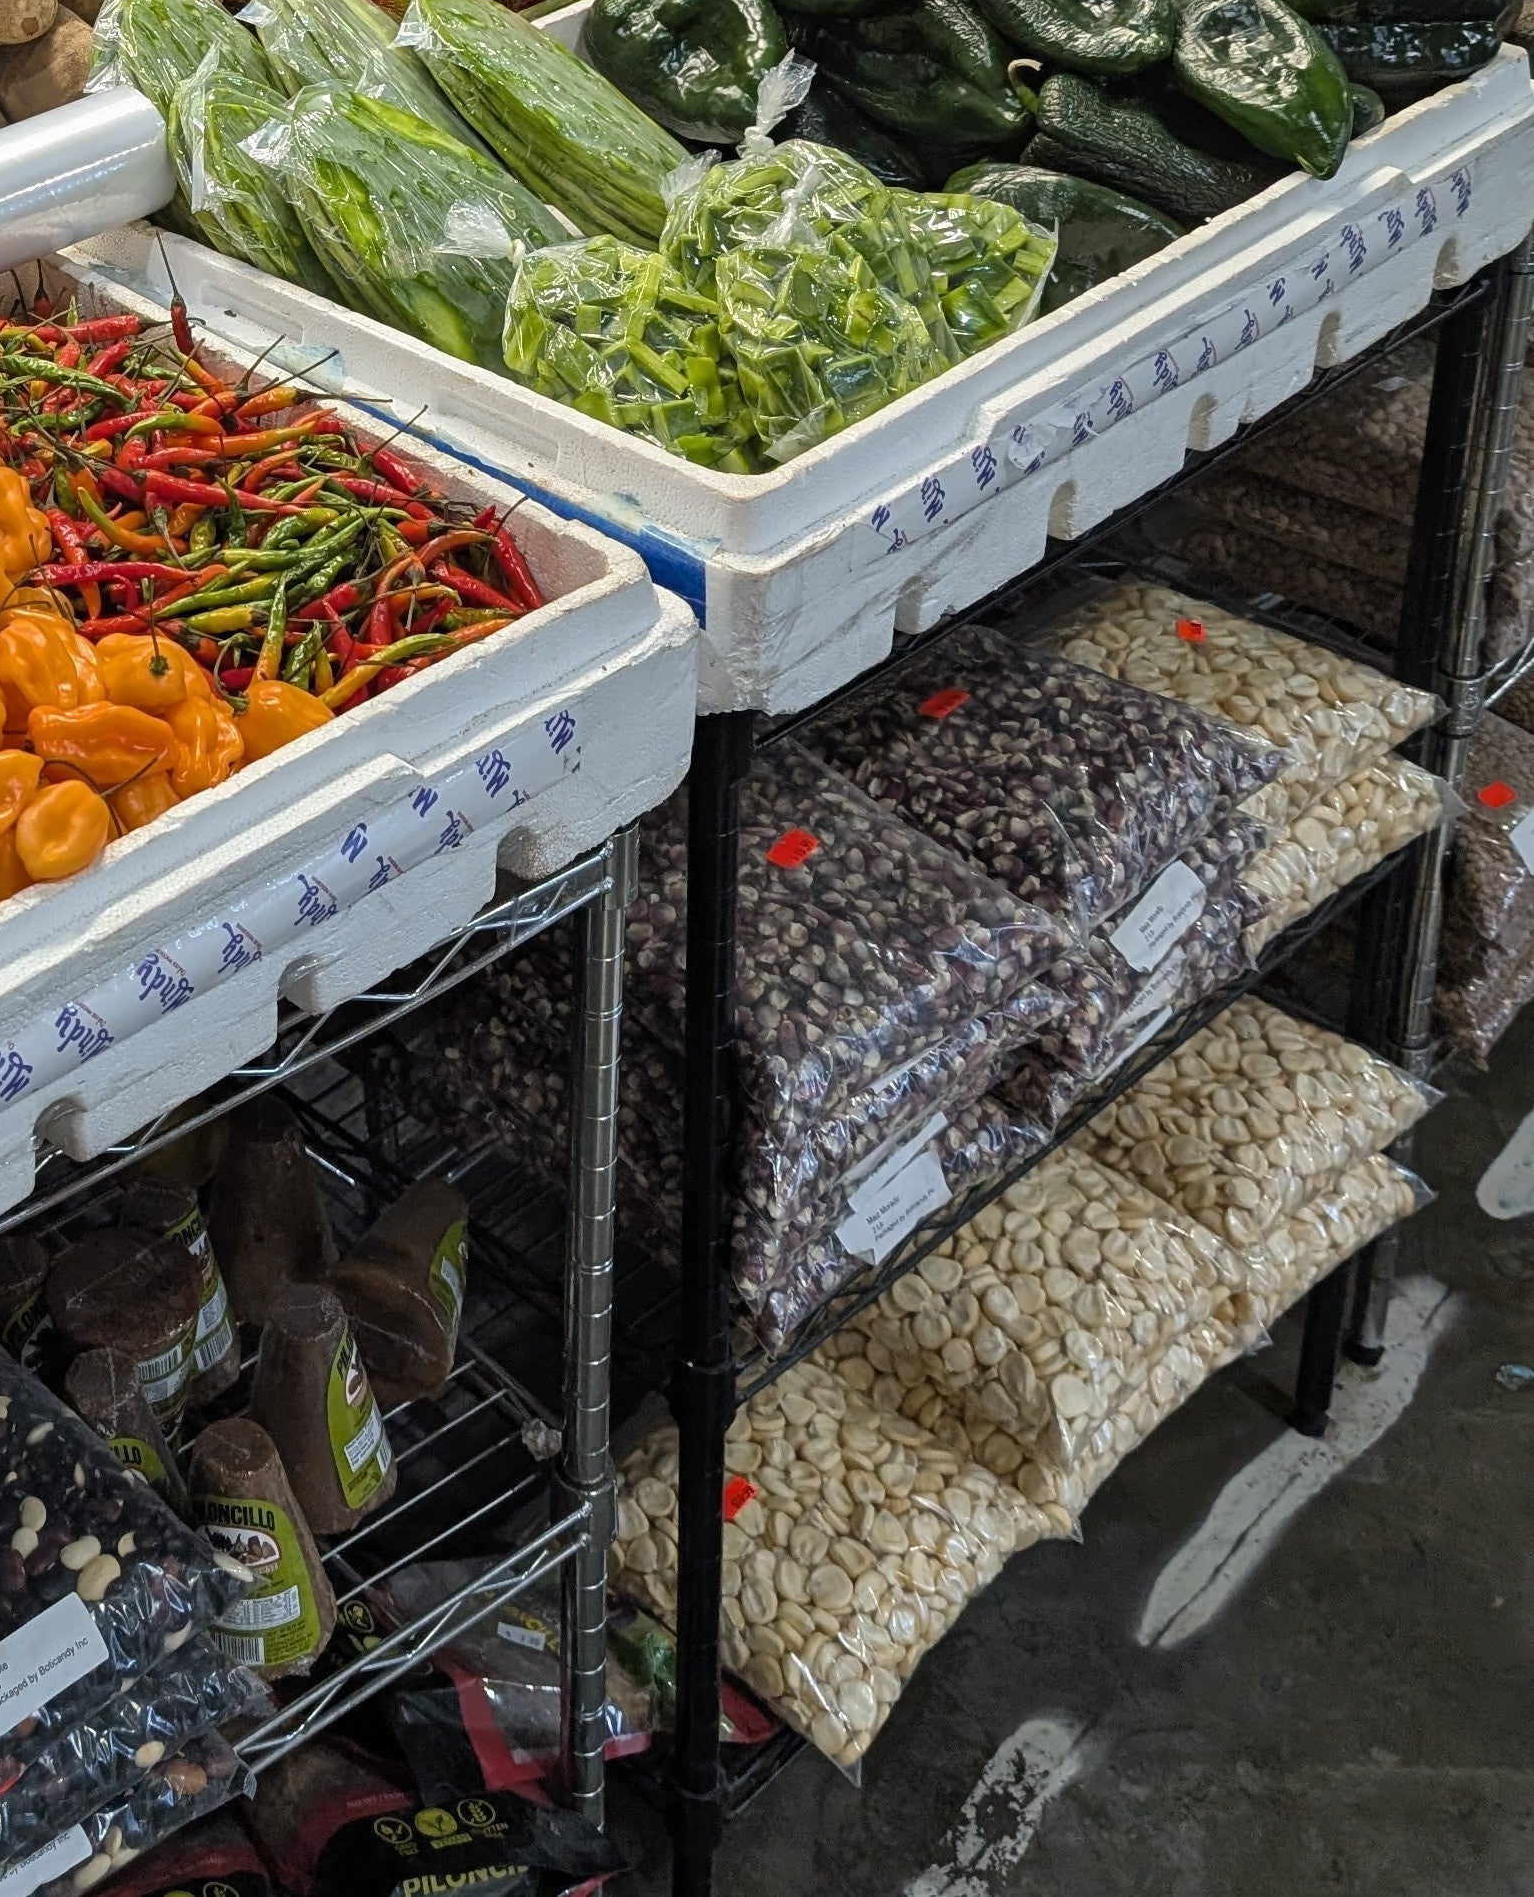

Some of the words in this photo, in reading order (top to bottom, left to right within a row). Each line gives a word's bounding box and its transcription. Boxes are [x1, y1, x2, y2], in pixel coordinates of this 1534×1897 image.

[27, 1672, 39, 1685] by
[38, 1646, 76, 1676] Boticandy
[74, 1636, 89, 1651] Inc
